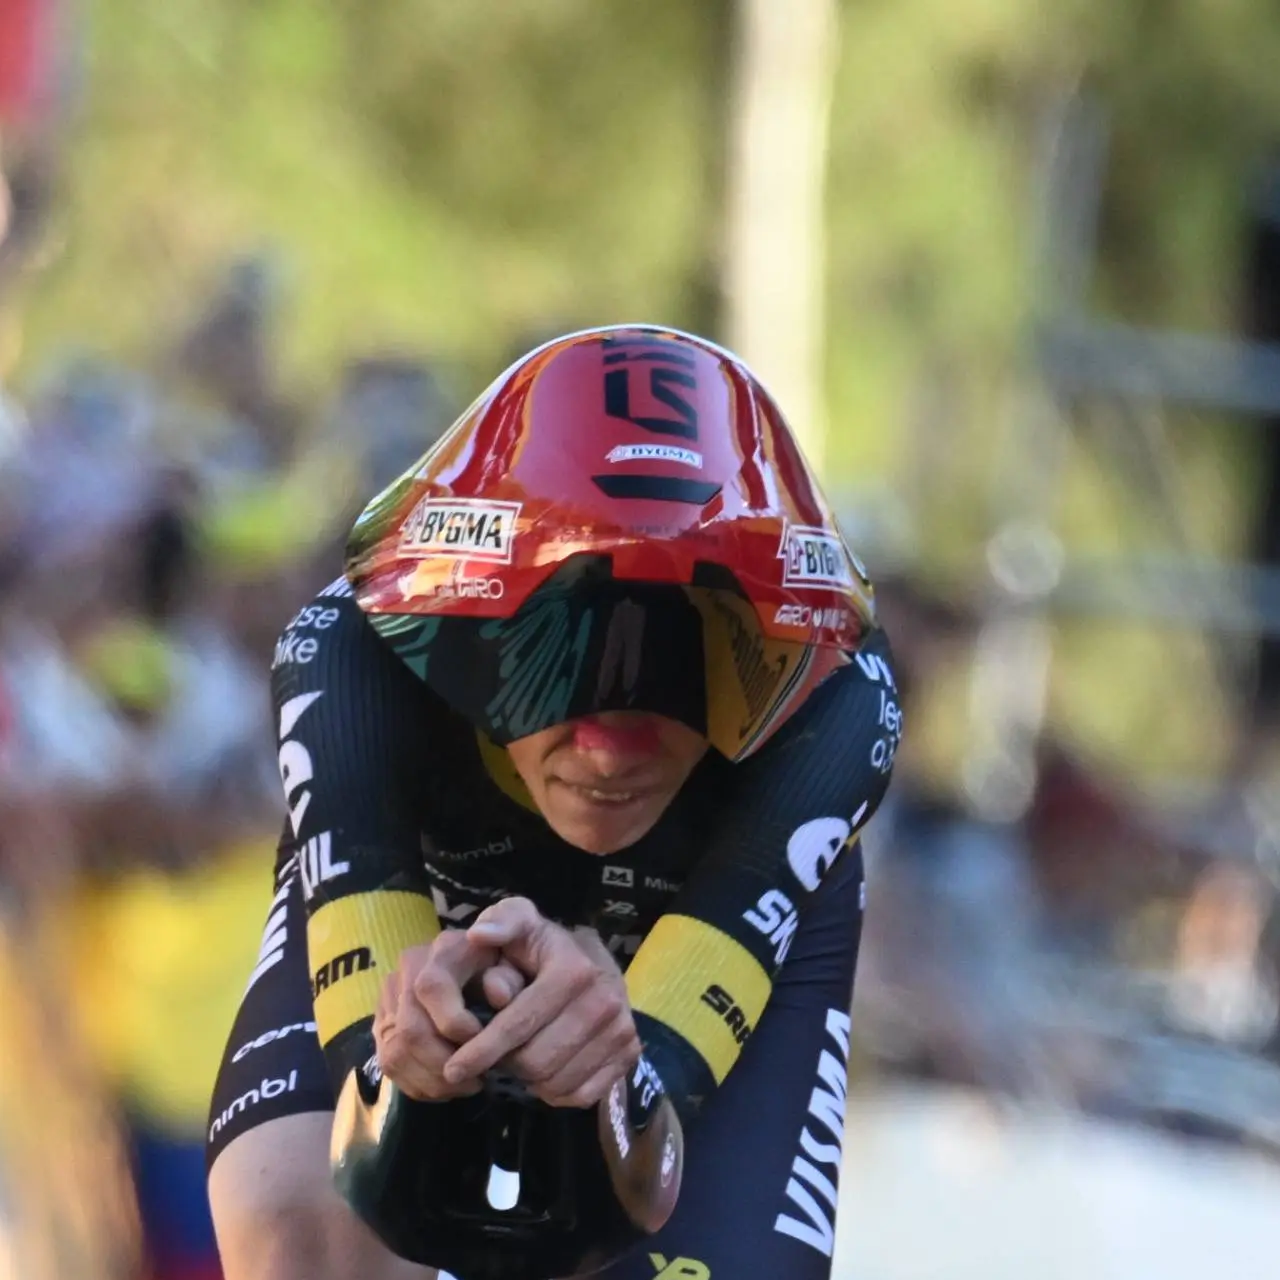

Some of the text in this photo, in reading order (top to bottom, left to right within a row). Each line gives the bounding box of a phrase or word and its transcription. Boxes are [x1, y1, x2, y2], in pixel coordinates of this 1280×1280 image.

[631, 447, 697, 463] BYGMA
[420, 511, 503, 549] BYGMA
[805, 539, 848, 578] BYG
[457, 578, 504, 600] GIRO
[773, 604, 812, 627] GIRO
[209, 1069, 298, 1143] nimbl
[773, 1007, 851, 1258] VISMA
